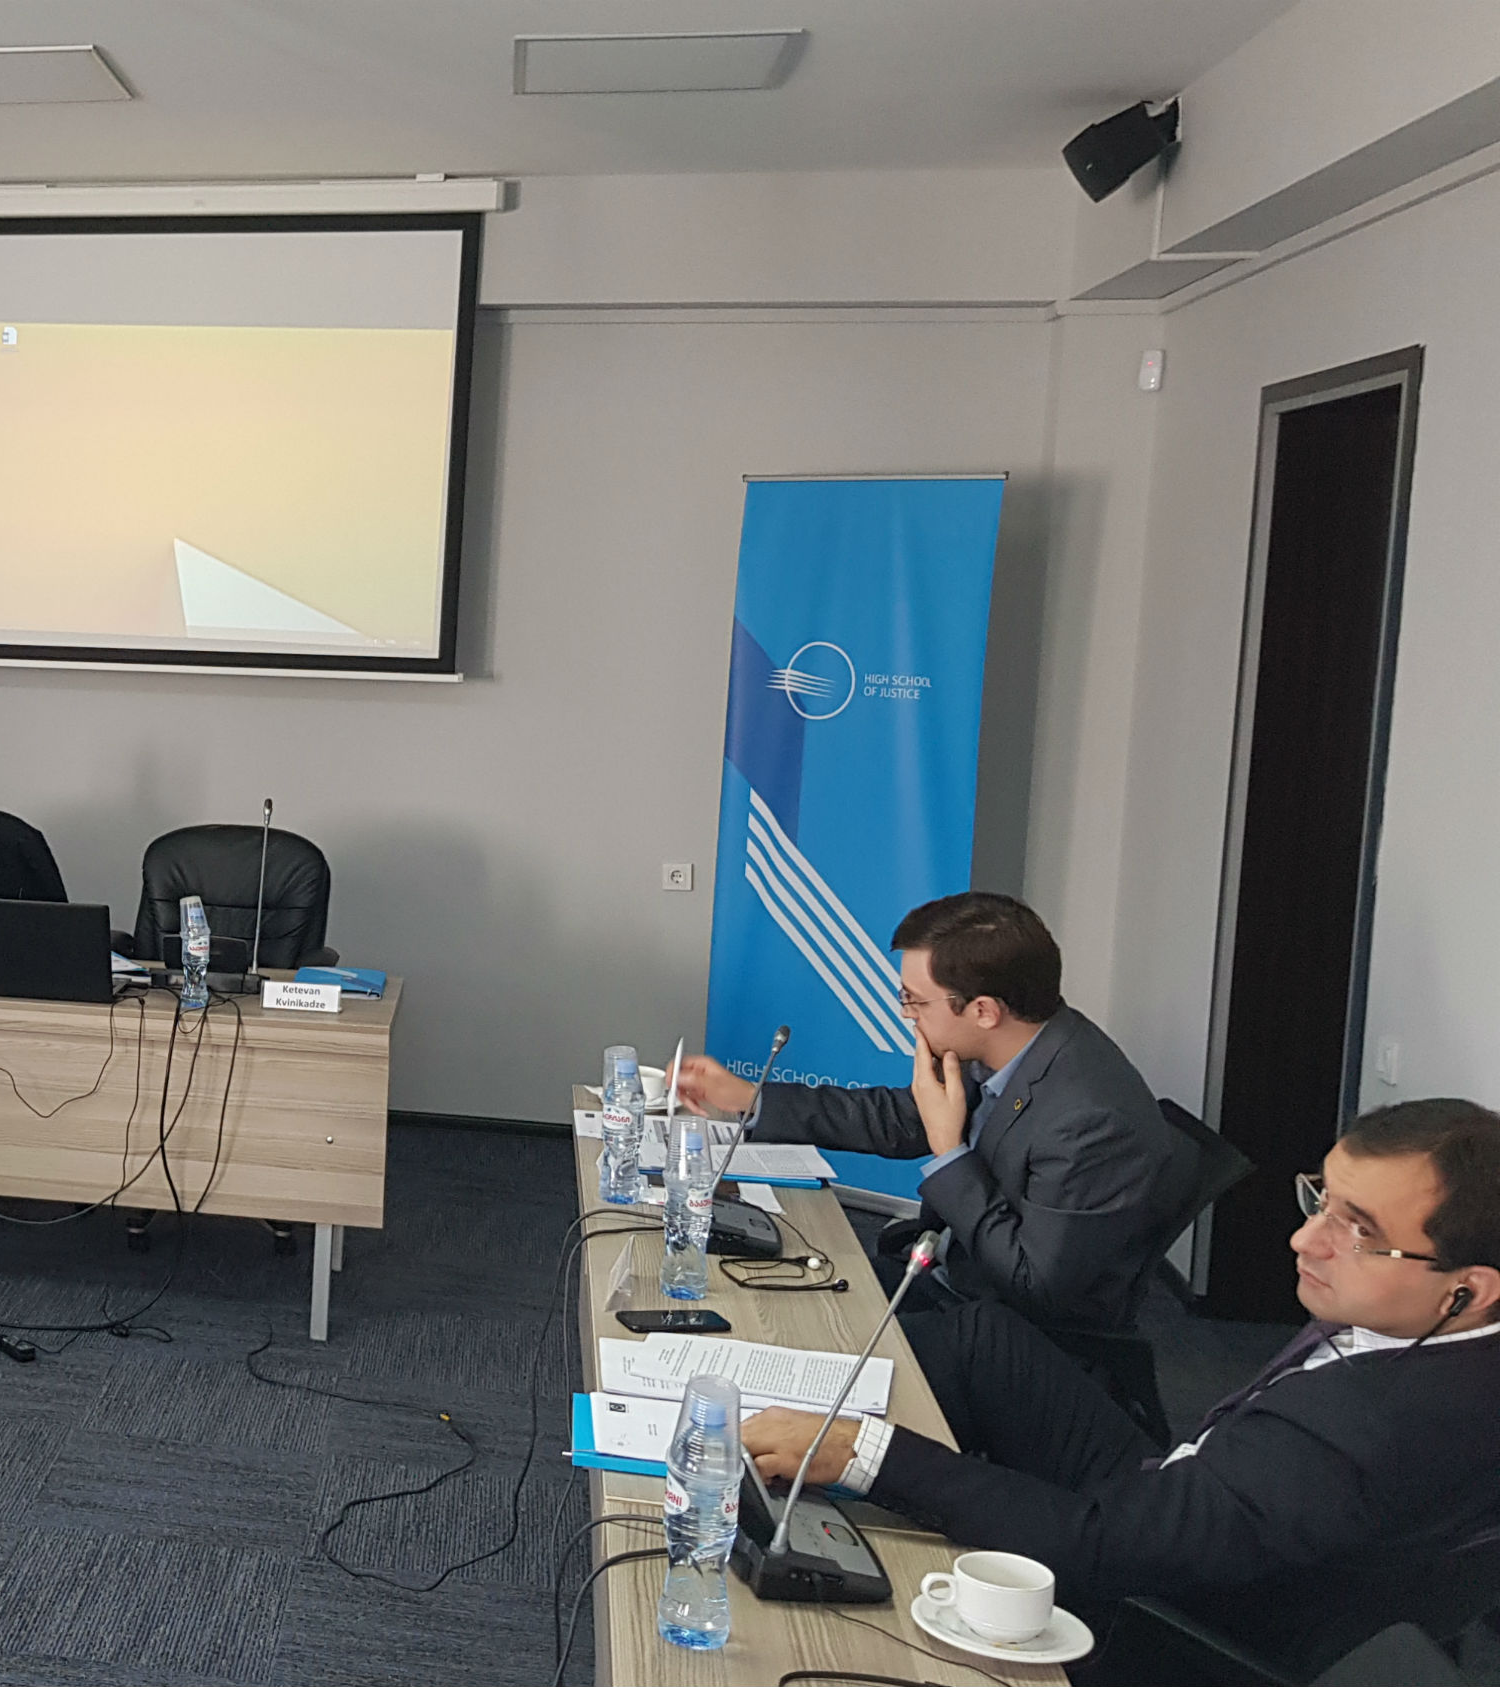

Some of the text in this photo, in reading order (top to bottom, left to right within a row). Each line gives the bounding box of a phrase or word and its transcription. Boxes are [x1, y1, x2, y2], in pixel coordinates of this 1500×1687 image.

[864, 673, 932, 688] HIGH SCHOOL
[863, 686, 921, 700] OF JUSTICE
[282, 985, 321, 995] Ketevan
[275, 997, 326, 1009] Kvinikadze
[726, 1059, 767, 1078] HIGH
